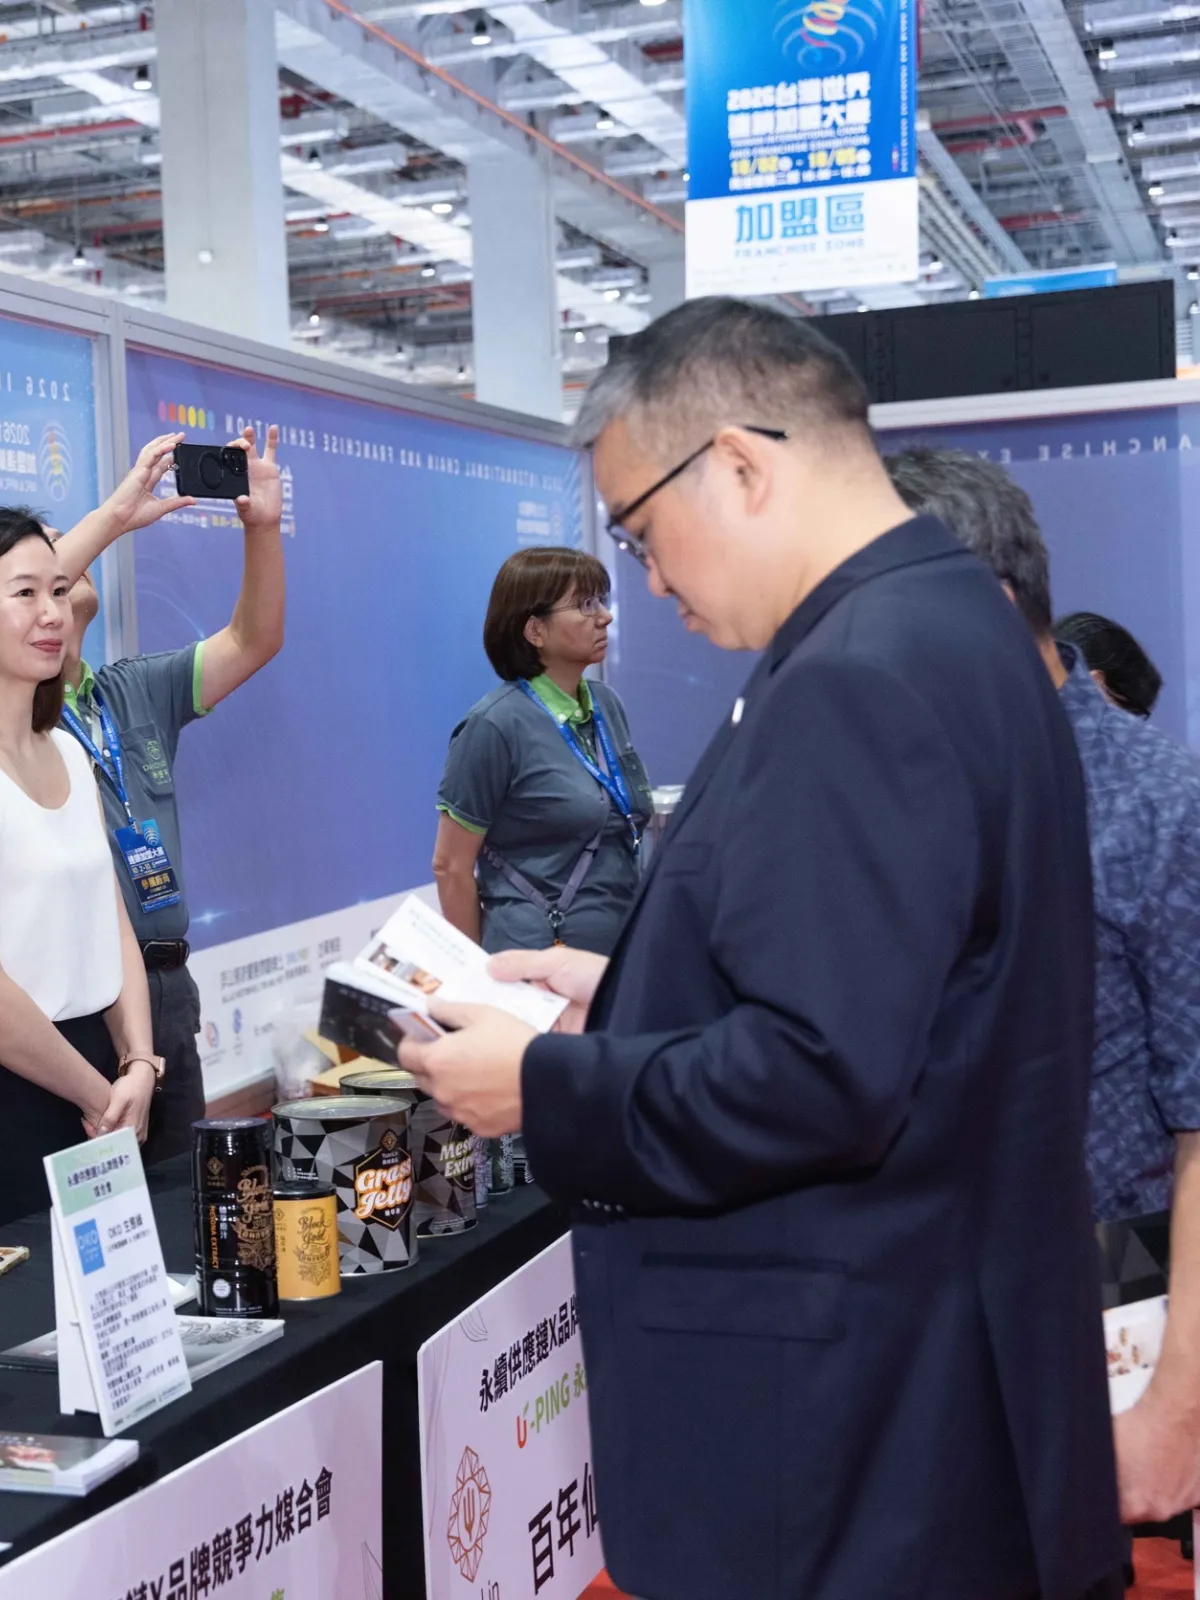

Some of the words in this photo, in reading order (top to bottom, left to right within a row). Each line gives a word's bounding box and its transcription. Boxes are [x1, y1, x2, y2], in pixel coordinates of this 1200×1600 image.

[735, 192, 865, 244] 加盟區
[77, 1228, 99, 1250] OKO
[573, 1362, 588, 1399] 永
